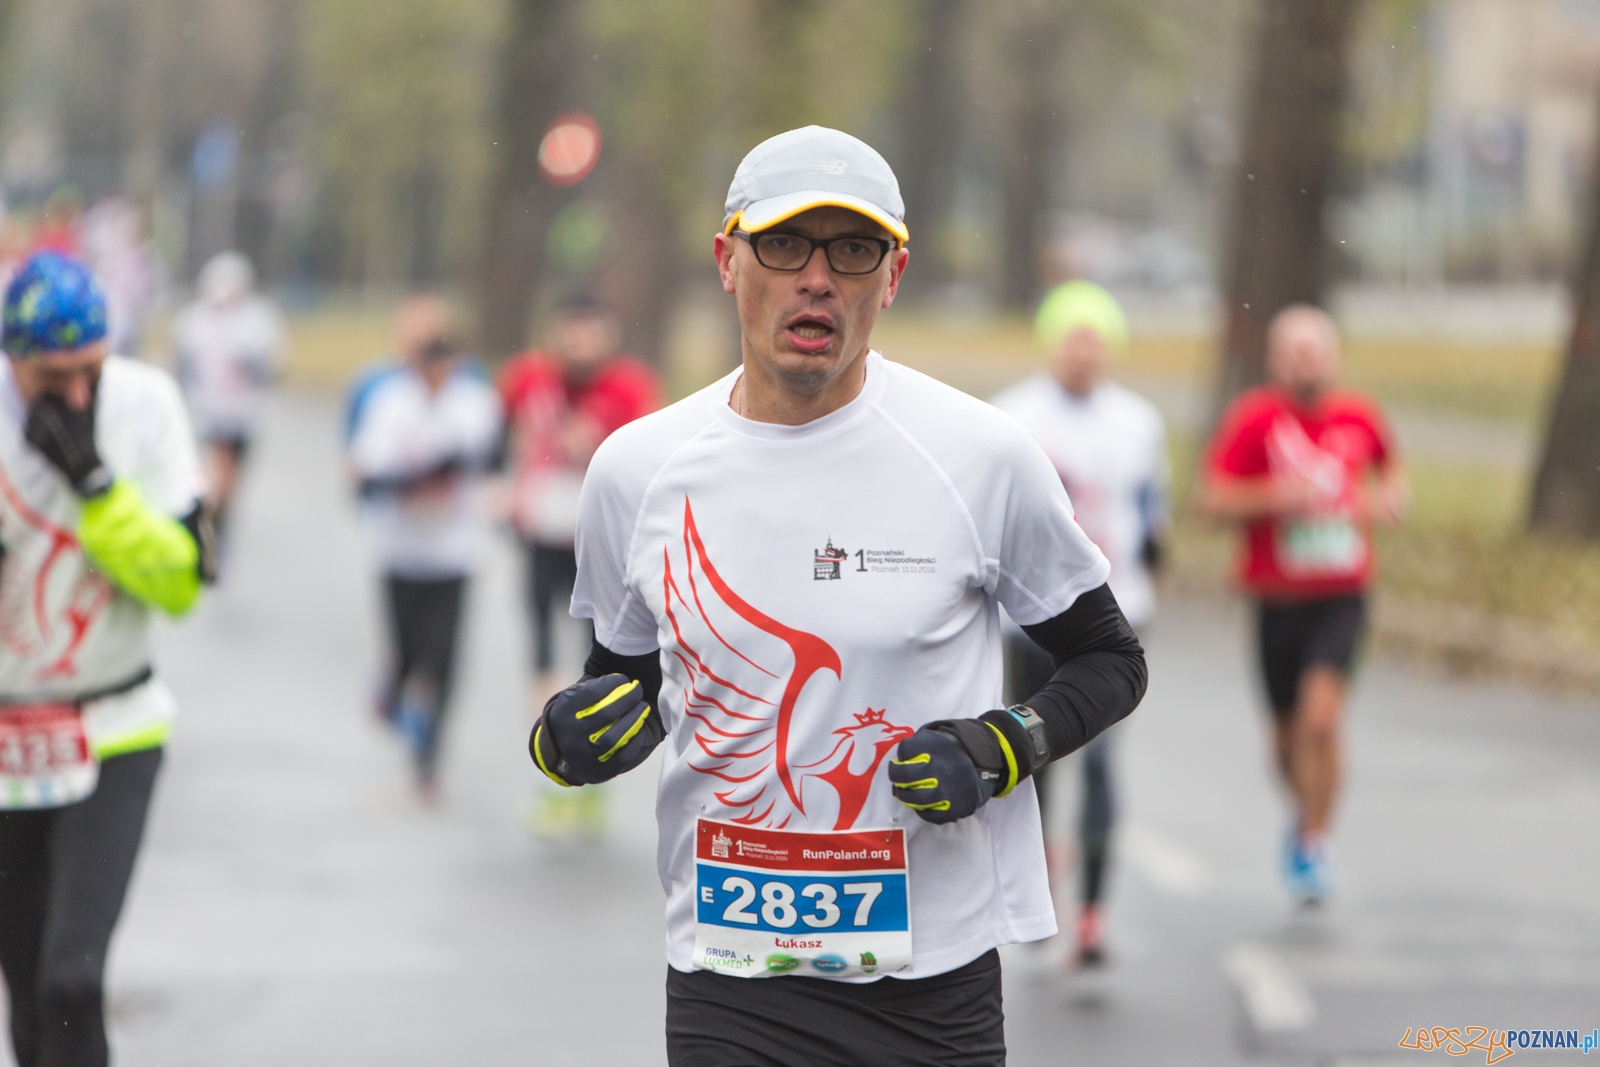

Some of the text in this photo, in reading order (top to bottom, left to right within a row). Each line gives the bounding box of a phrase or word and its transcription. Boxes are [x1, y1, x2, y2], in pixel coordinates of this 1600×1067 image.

[866, 549, 905, 557] Poznański
[855, 549, 868, 572] 1
[735, 839, 745, 856] 1
[803, 849, 891, 861] RunPoland.org
[701, 886, 715, 904] E
[721, 876, 884, 930] 2837
[774, 937, 823, 949] Łukasz
[705, 947, 737, 960] GRUPA
[703, 956, 743, 970] LUXMED
